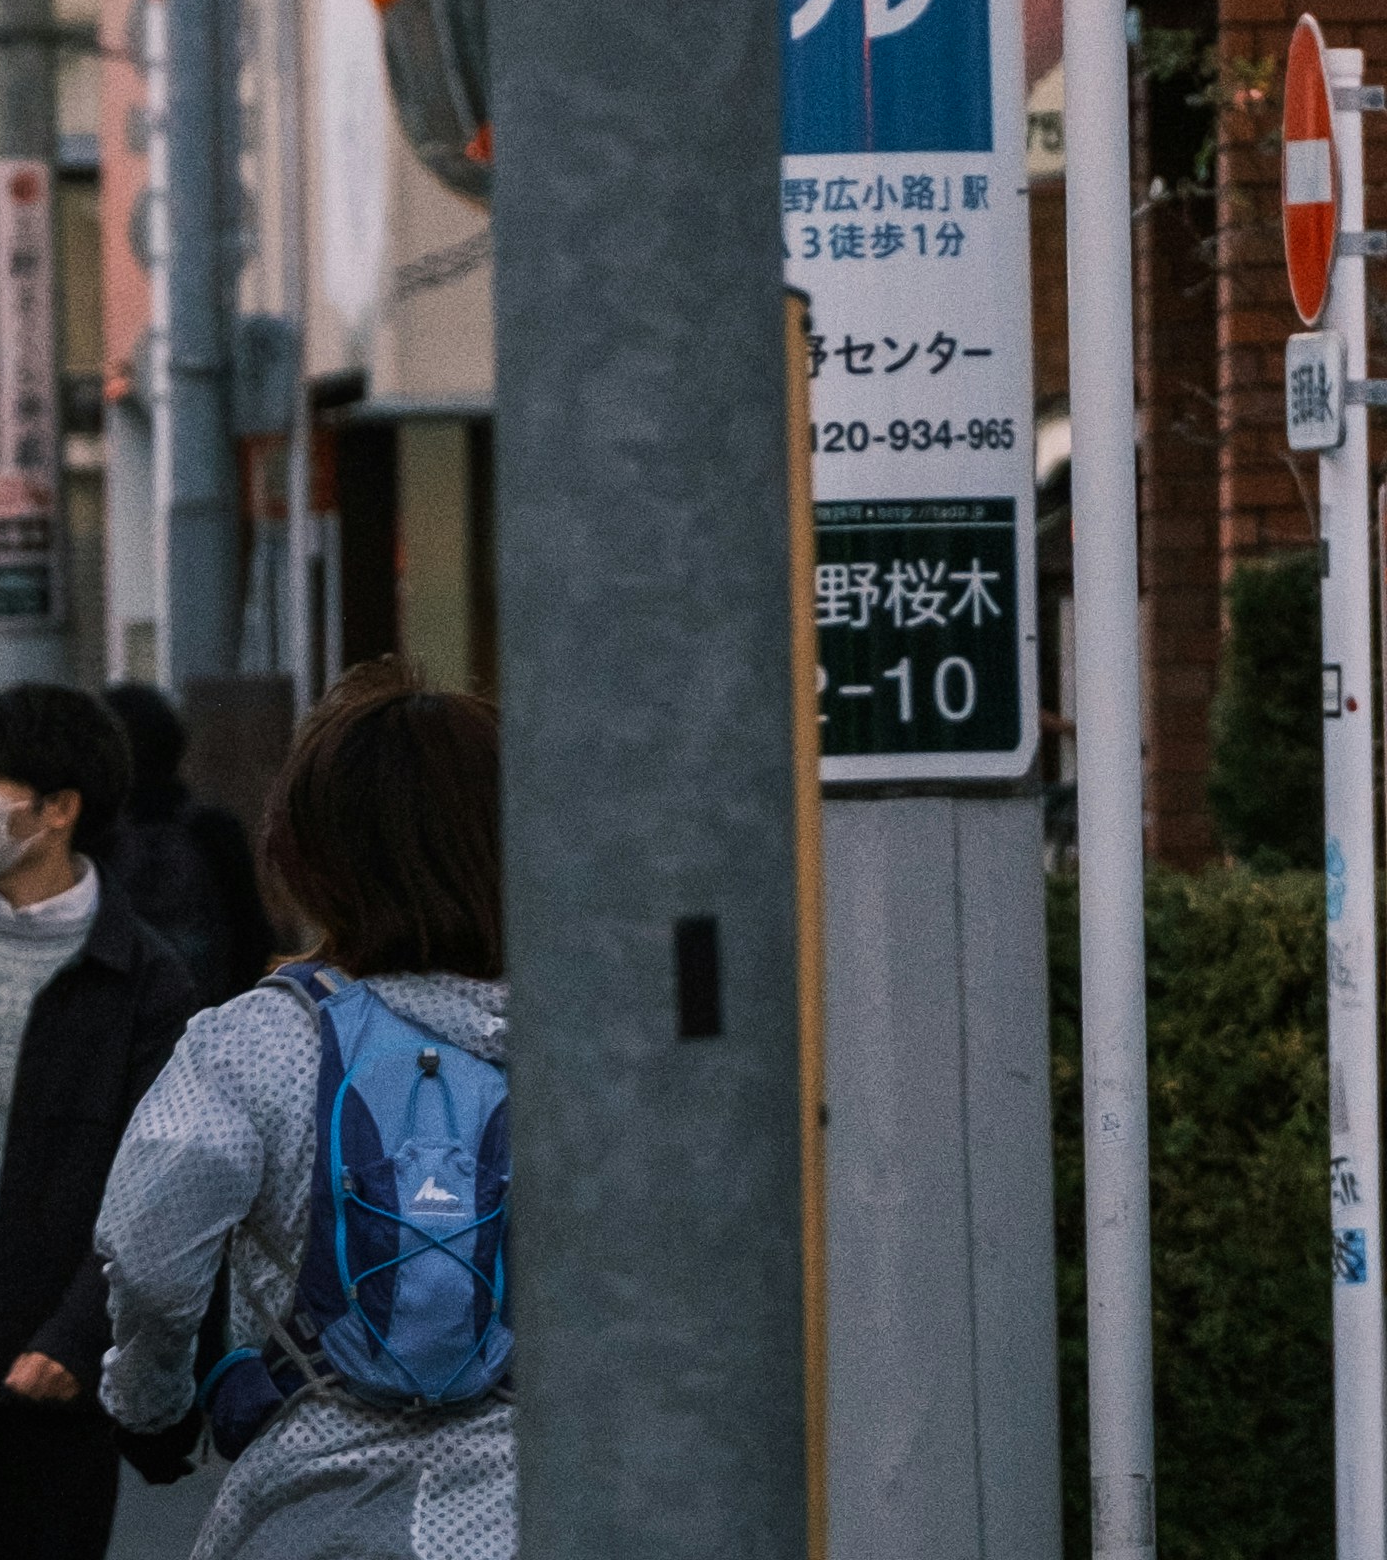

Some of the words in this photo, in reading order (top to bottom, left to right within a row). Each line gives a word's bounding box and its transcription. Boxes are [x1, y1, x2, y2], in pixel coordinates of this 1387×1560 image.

[782, 221, 966, 261] 3徒歩1分
[815, 557, 1002, 630] 野桜木
